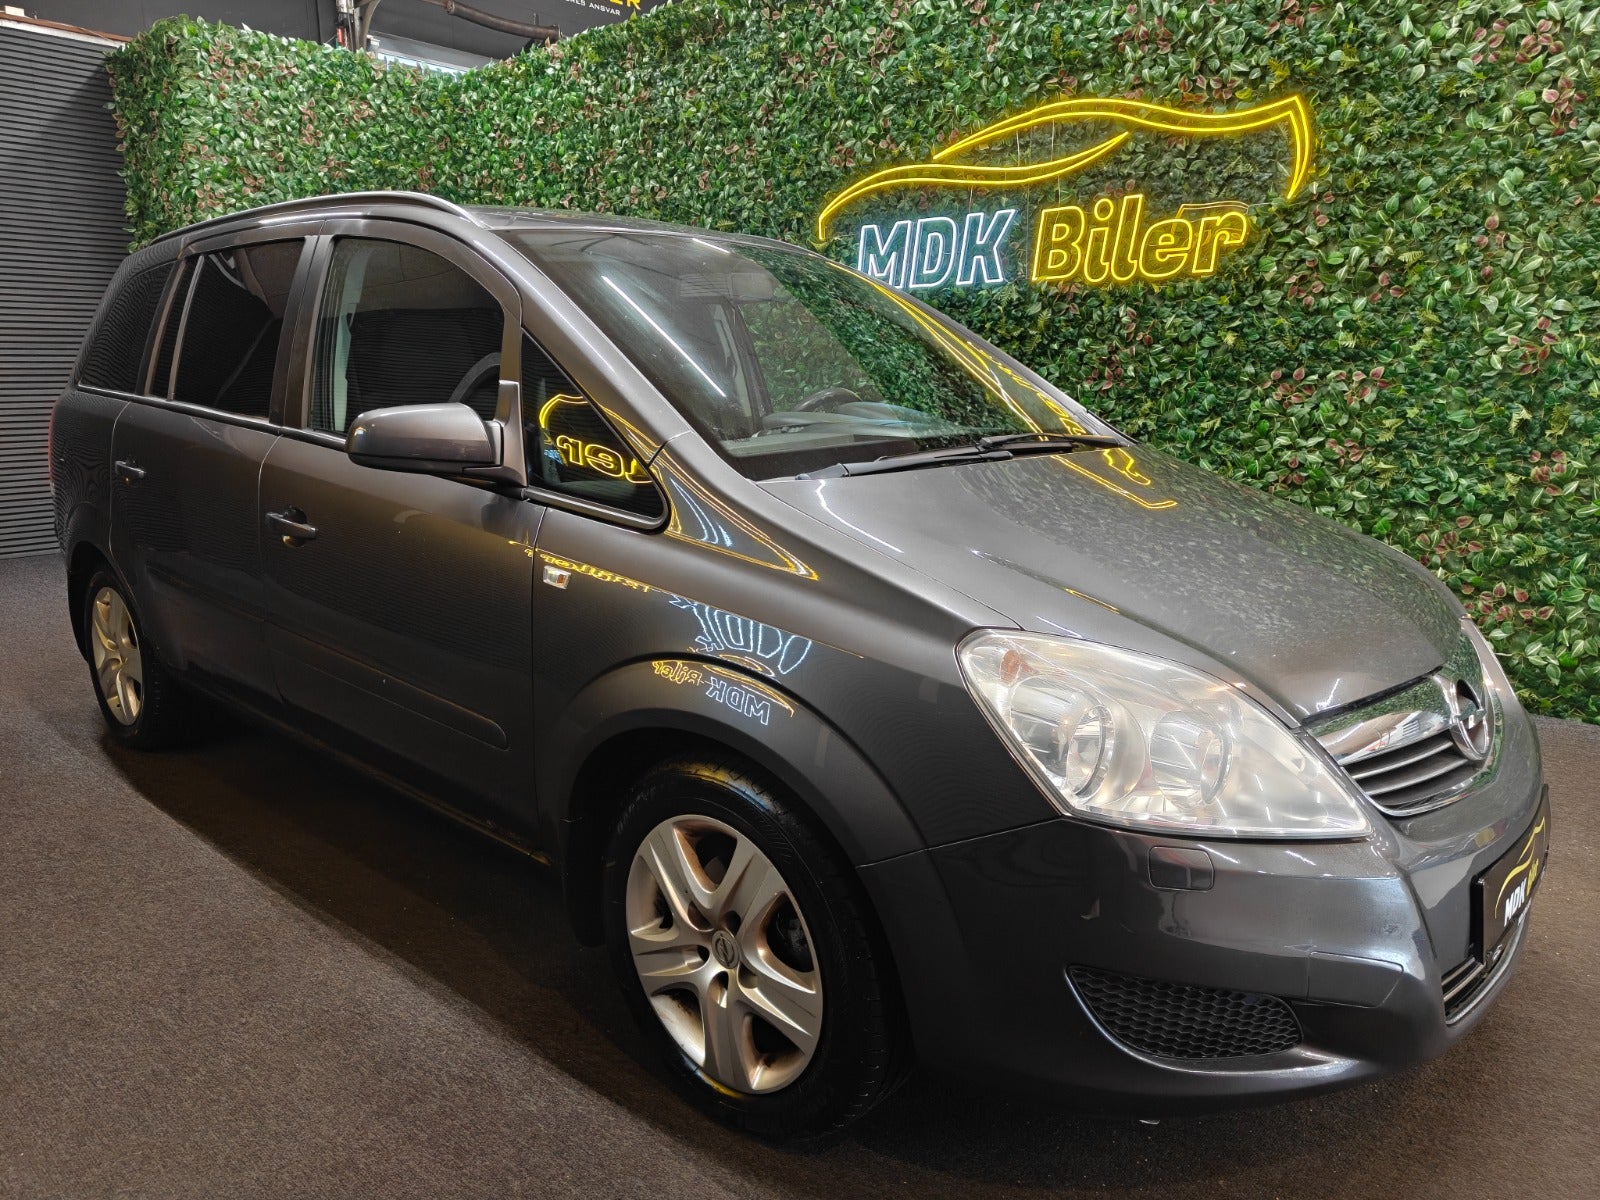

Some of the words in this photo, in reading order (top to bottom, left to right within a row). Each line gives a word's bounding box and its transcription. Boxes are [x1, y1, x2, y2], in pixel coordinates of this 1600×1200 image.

[589, 2, 621, 16] ANSVAR
[857, 208, 1017, 290] MDK
[1031, 193, 1248, 283] Biler
